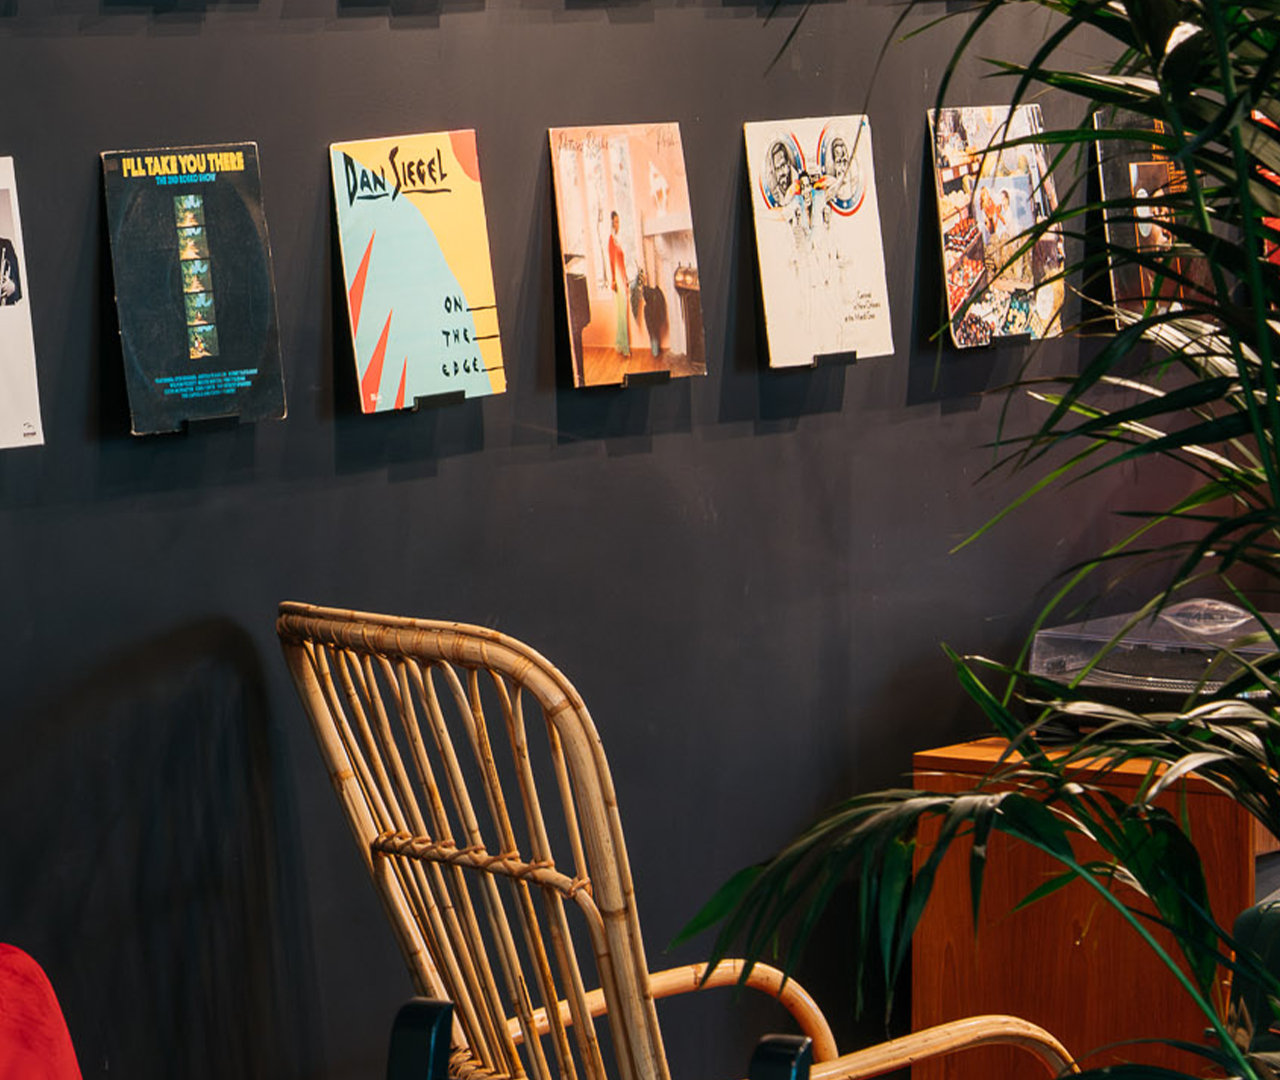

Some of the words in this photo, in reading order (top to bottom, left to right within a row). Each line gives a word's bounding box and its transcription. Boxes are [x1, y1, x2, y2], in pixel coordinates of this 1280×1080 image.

[122, 156, 146, 178] I'LL
[145, 155, 179, 176] TAKE
[178, 153, 207, 174] YOU
[207, 151, 244, 172] THERE
[444, 295, 464, 314] ON
[442, 327, 472, 349] THE
[441, 356, 481, 378] EDGE
